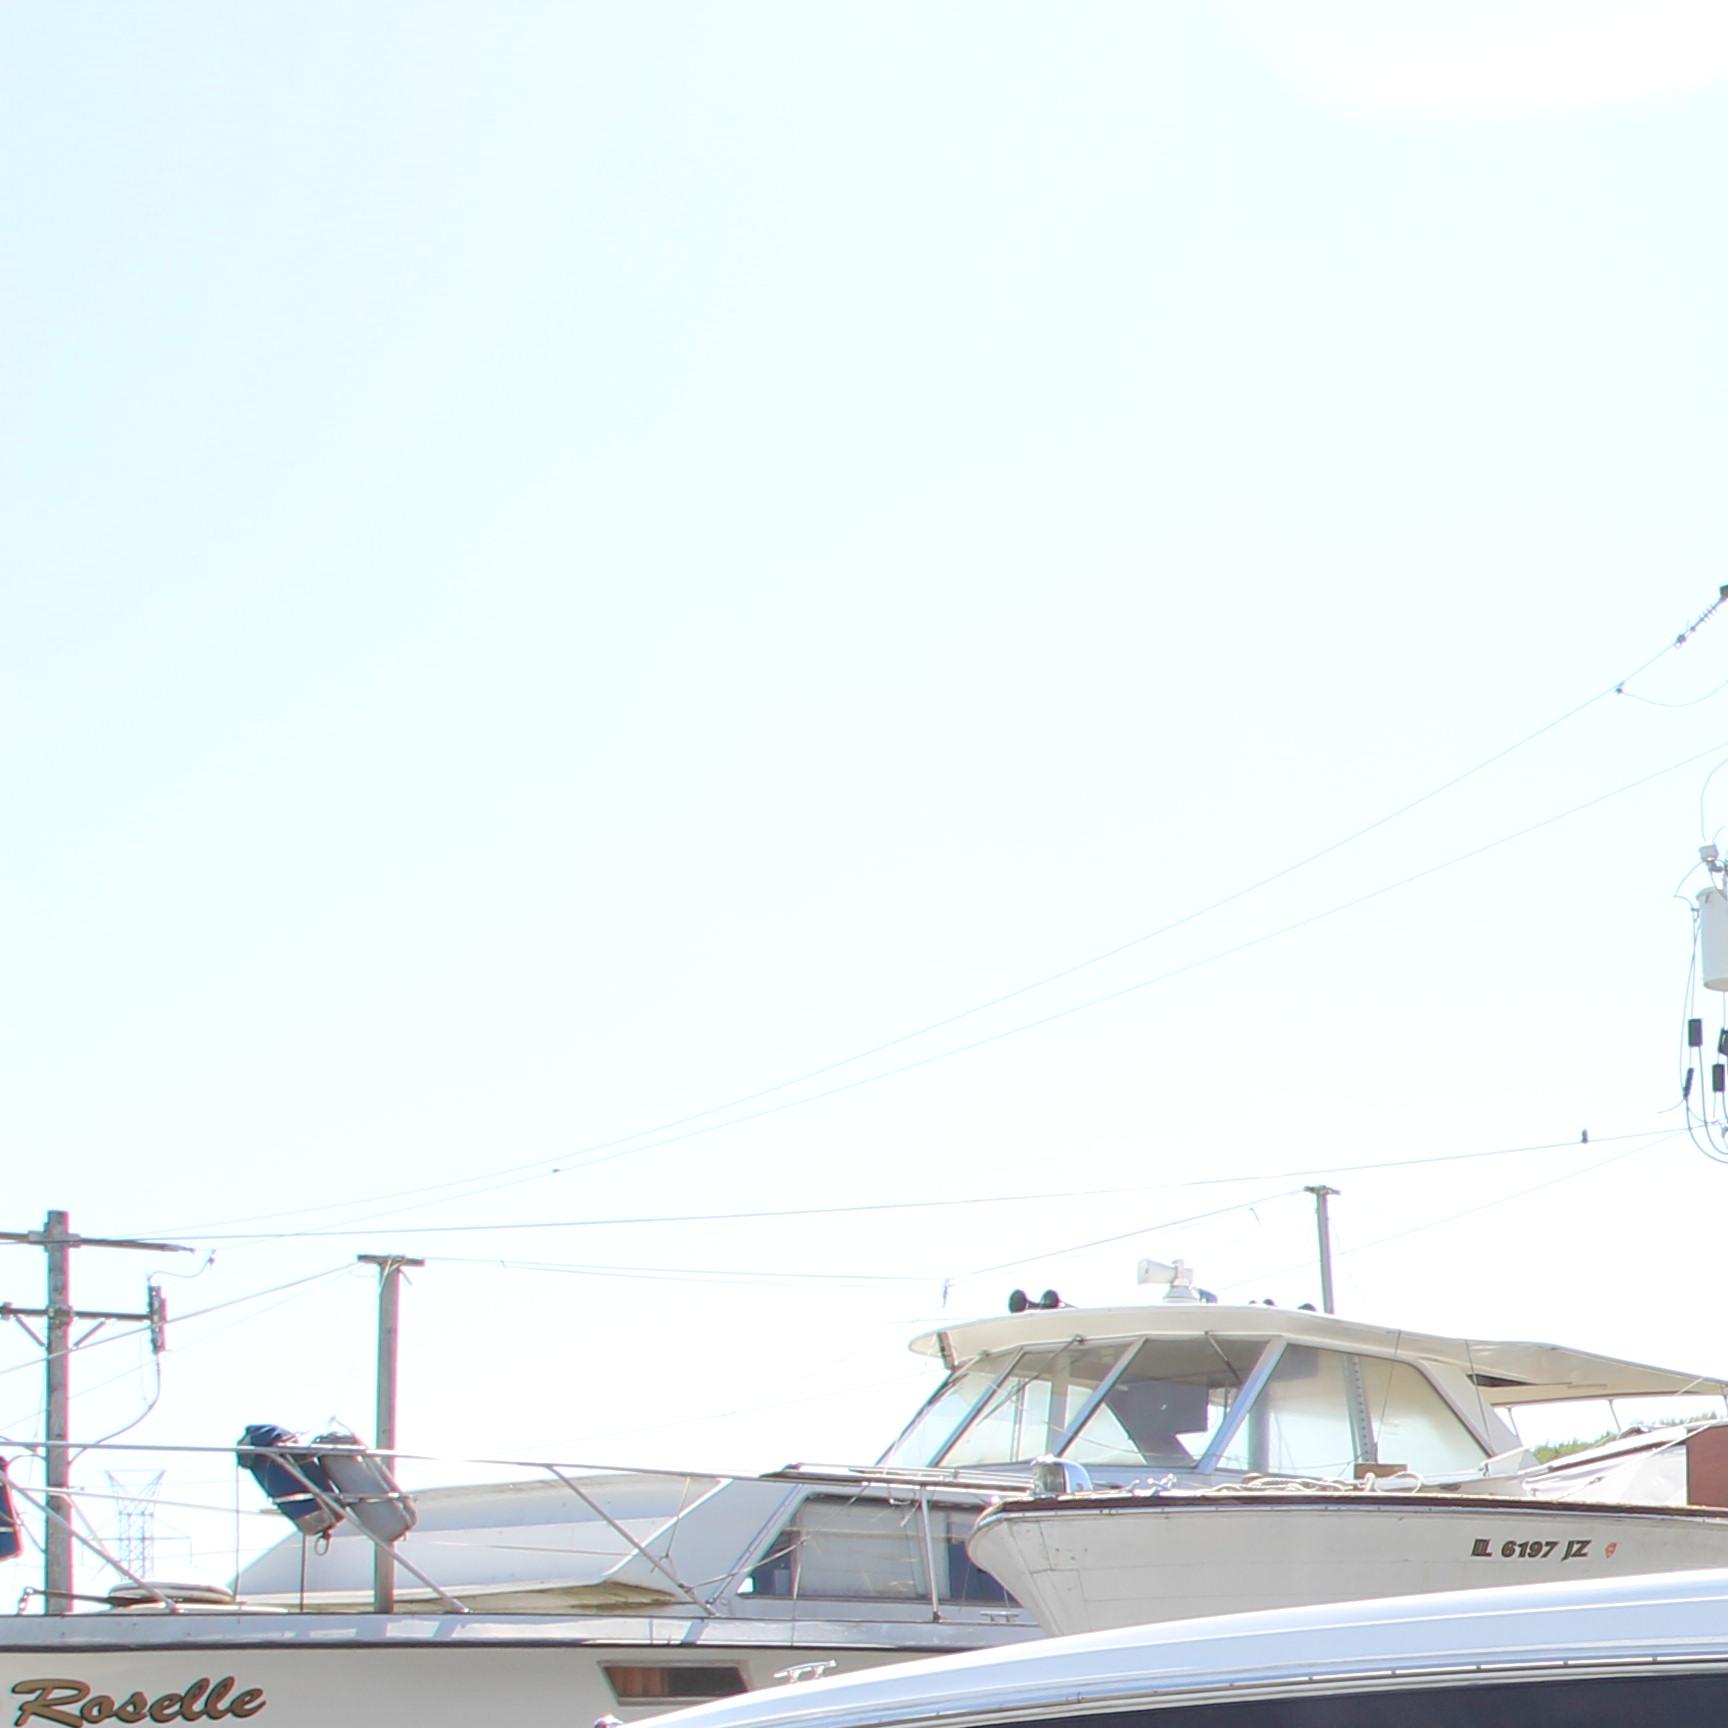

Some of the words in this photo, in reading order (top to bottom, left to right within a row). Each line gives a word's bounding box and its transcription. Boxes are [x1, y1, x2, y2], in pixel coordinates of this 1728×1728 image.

[1471, 1538, 1492, 1557] IL
[1501, 1540, 1559, 1558] 6197
[1561, 1539, 1592, 1561] JZ
[11, 1675, 267, 1728] Roselle
